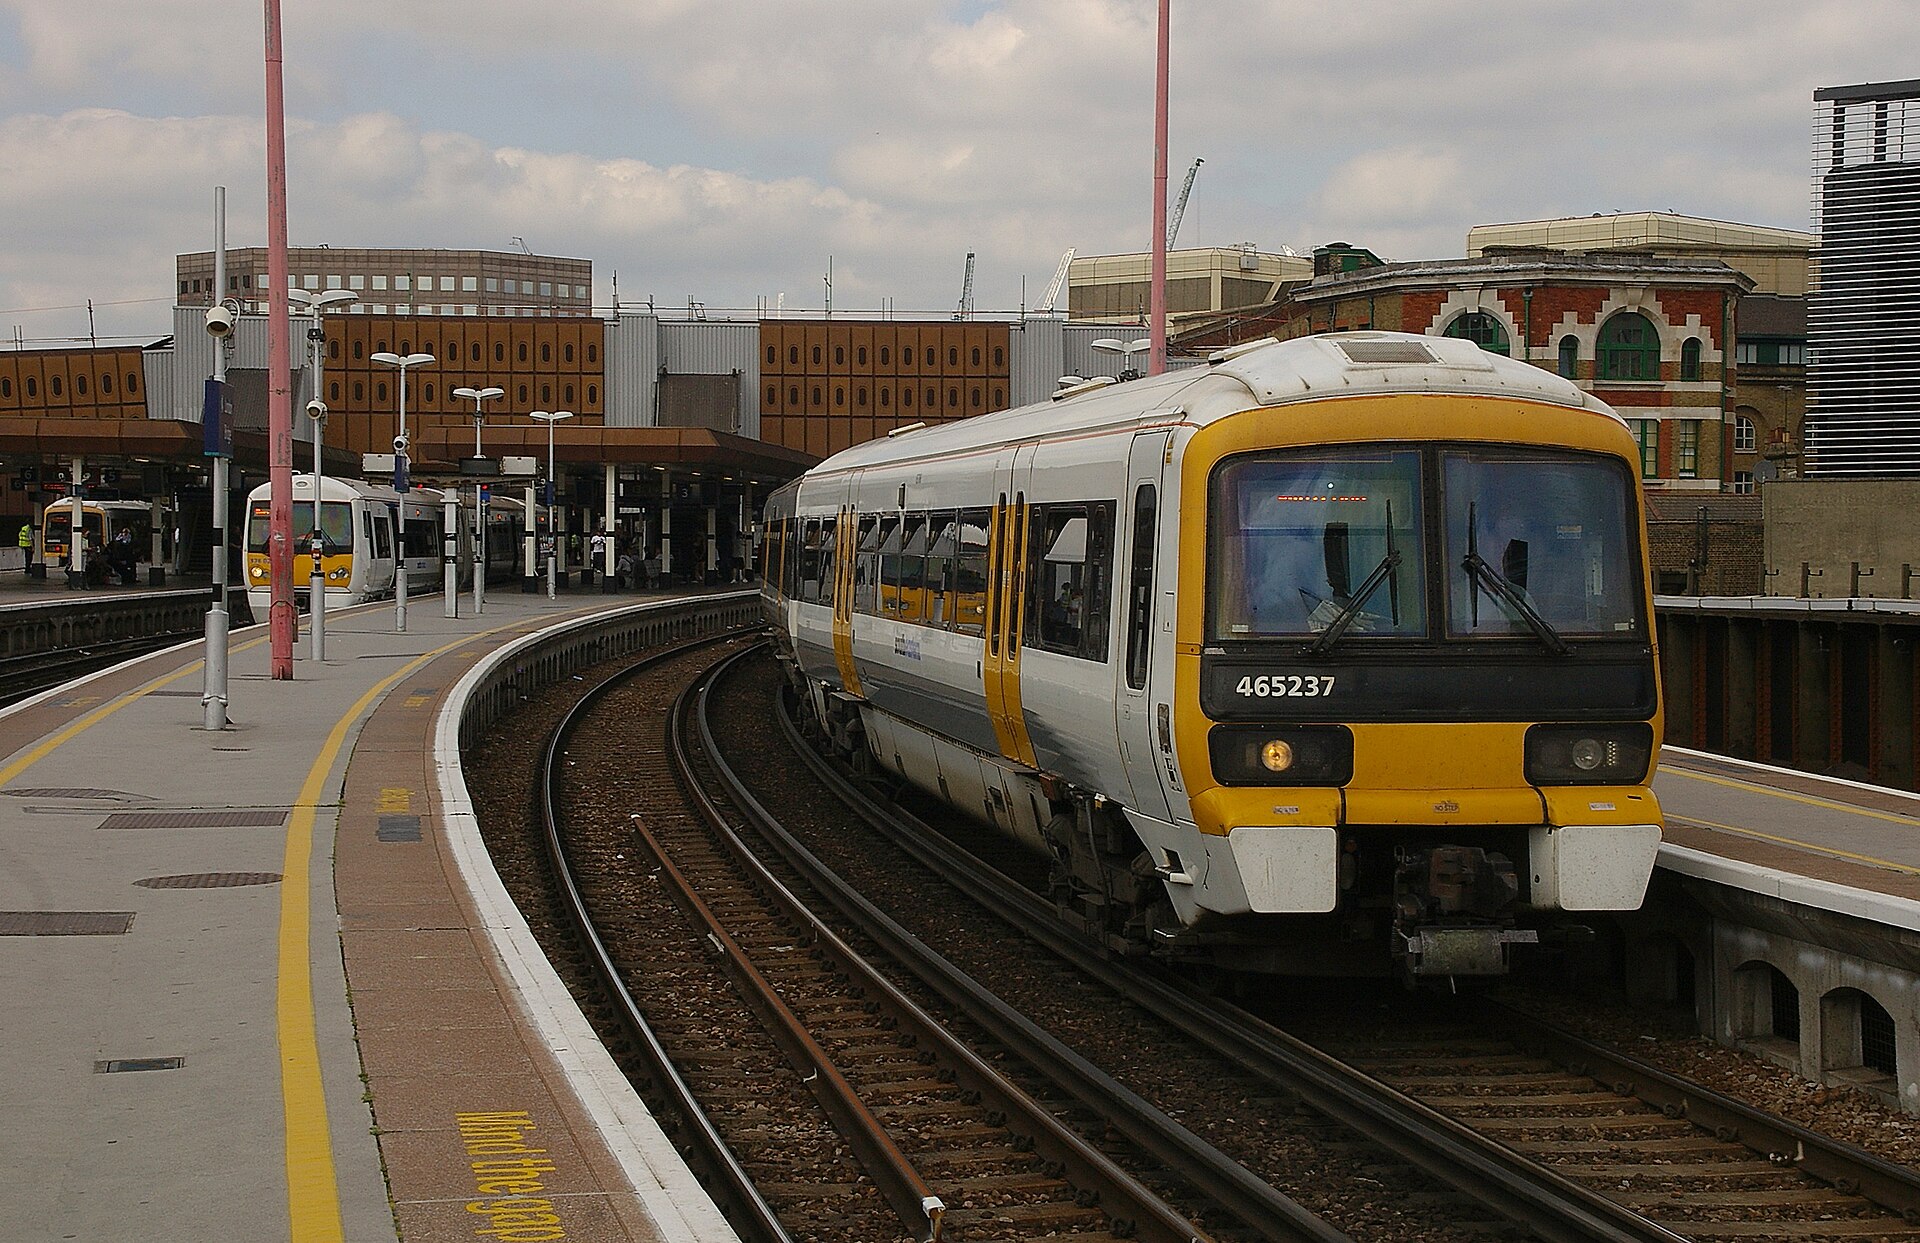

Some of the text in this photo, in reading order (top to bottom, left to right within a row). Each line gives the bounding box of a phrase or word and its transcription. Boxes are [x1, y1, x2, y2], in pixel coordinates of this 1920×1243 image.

[681, 487, 689, 499] 3
[1235, 675, 1336, 697] 465237
[455, 1111, 566, 1243] Mind the gap
